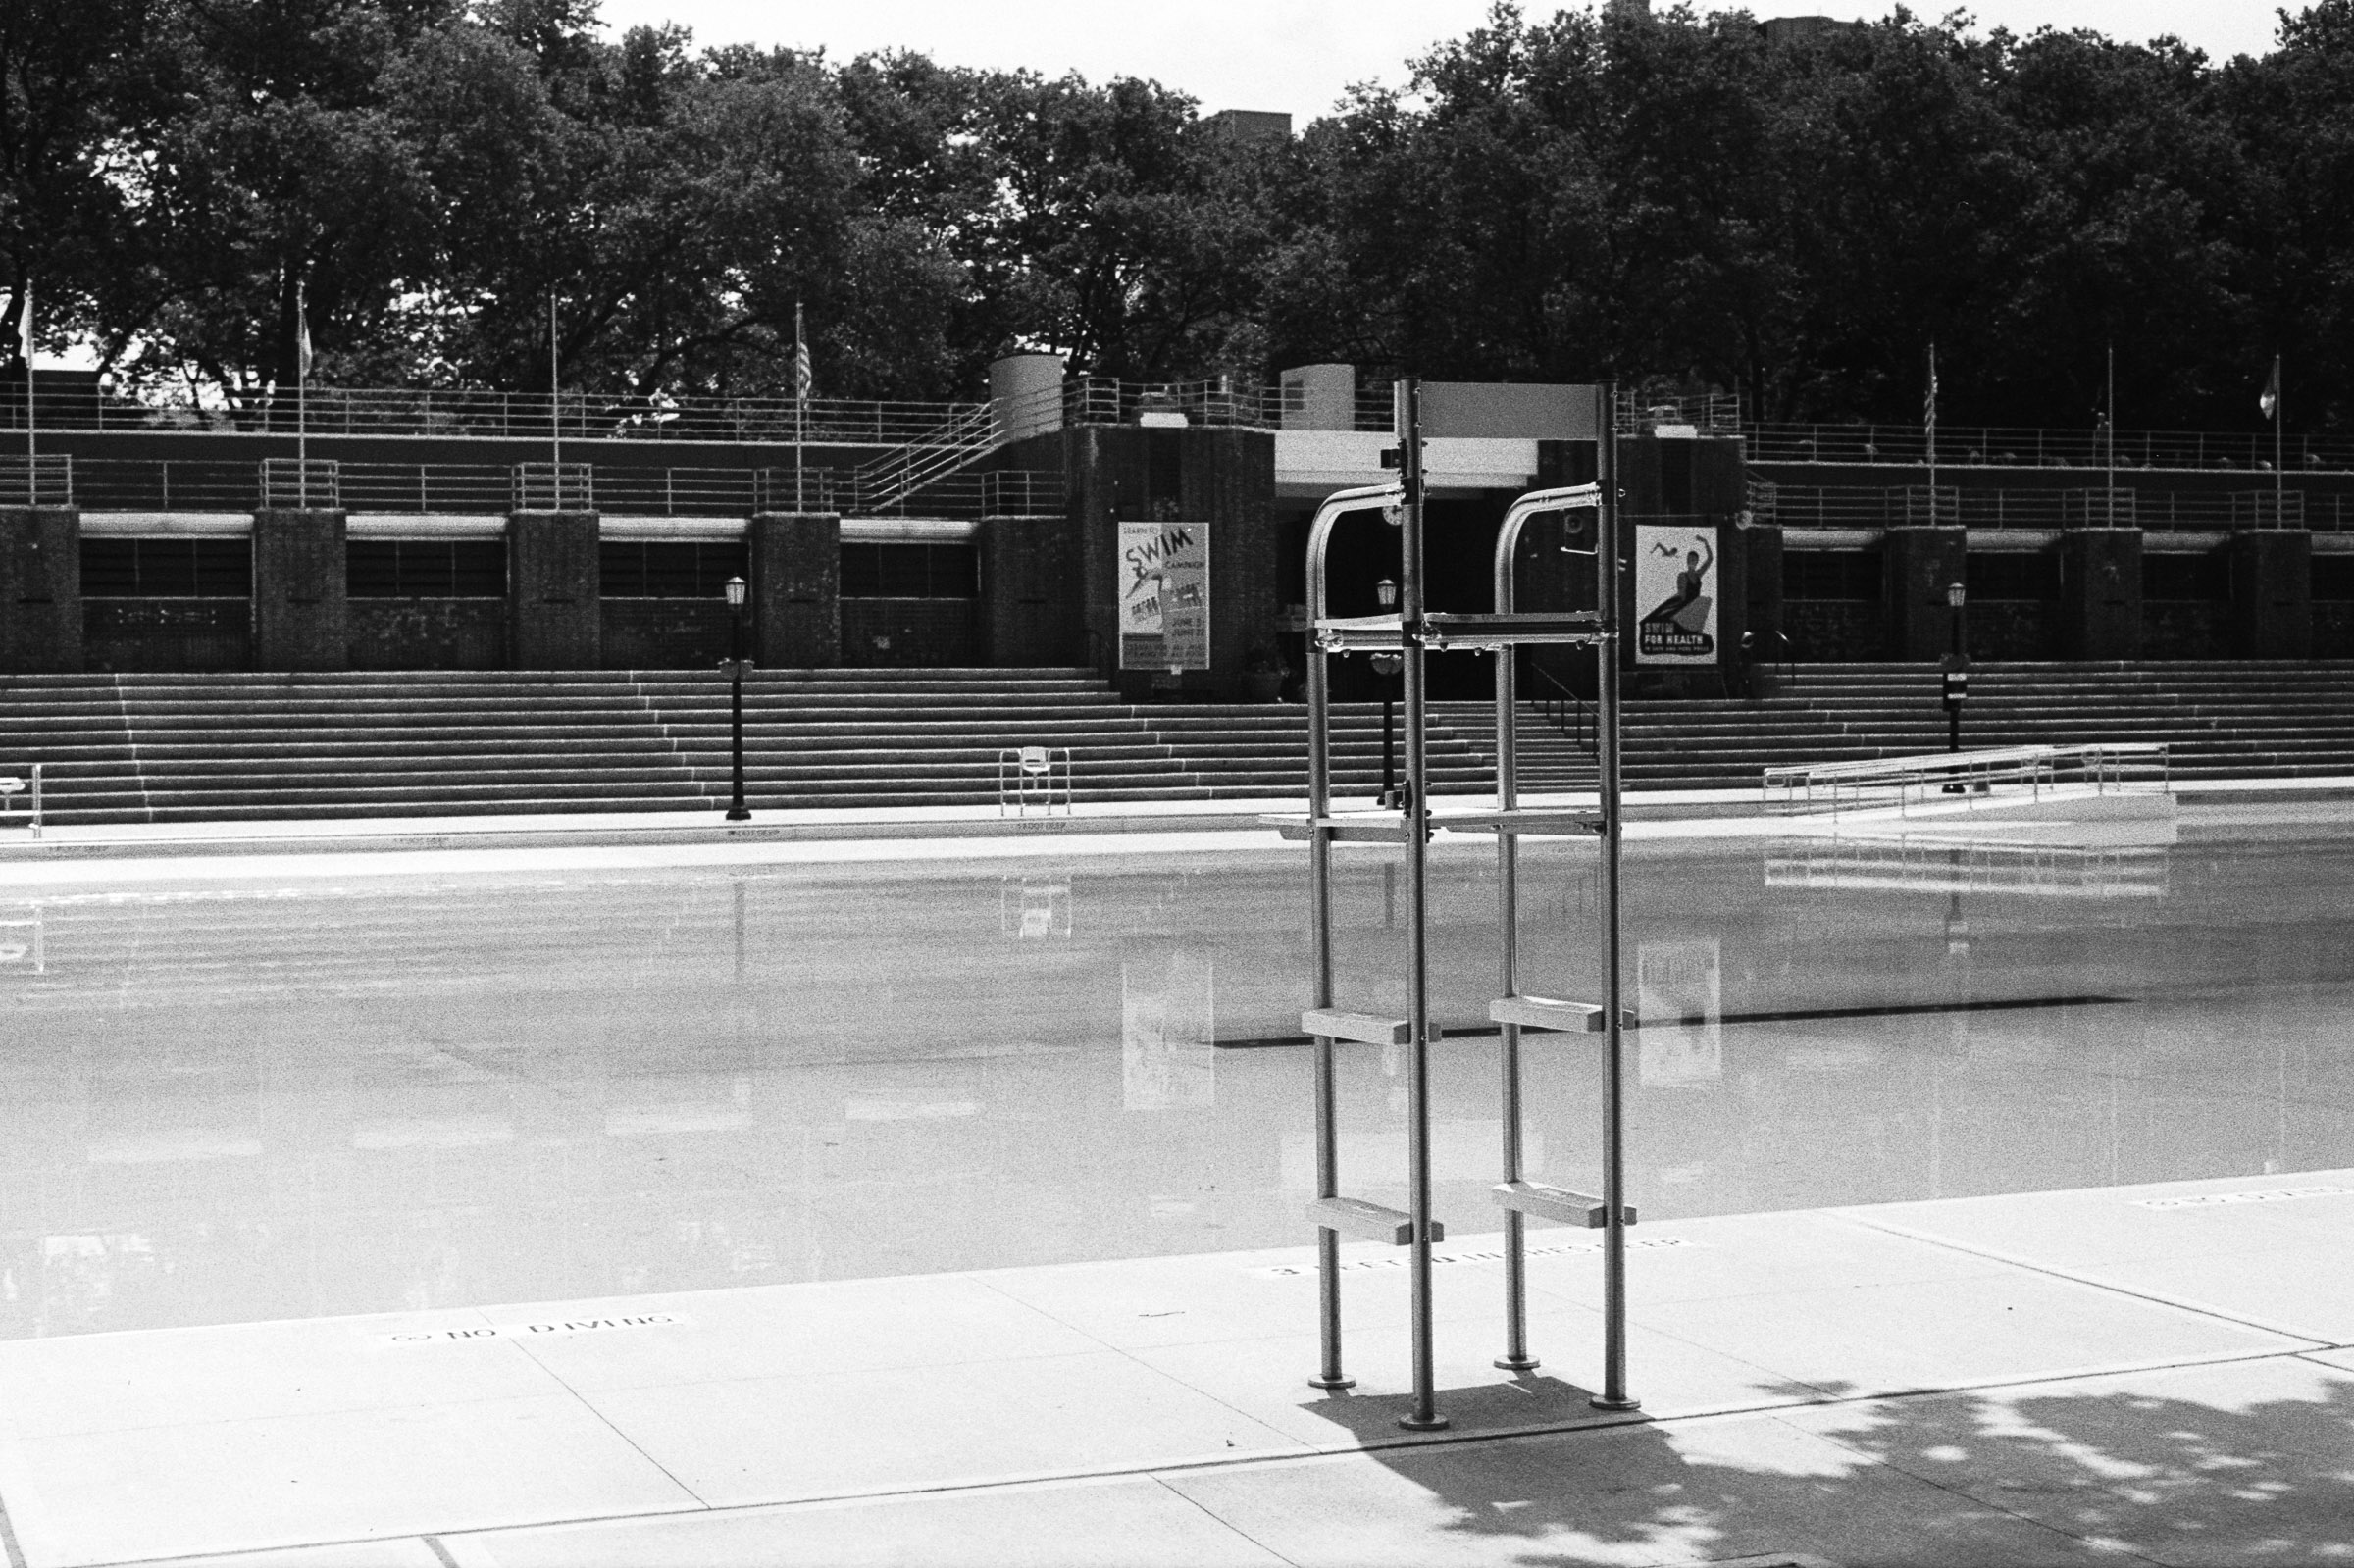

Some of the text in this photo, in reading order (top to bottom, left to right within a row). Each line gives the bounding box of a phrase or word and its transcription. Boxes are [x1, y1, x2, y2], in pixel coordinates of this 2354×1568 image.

[1126, 528, 1194, 567] SWIM
[1644, 622, 1674, 633] SWIM
[1644, 634, 1704, 645] FOR HEALTH
[447, 1315, 675, 1340] NO DIVING
